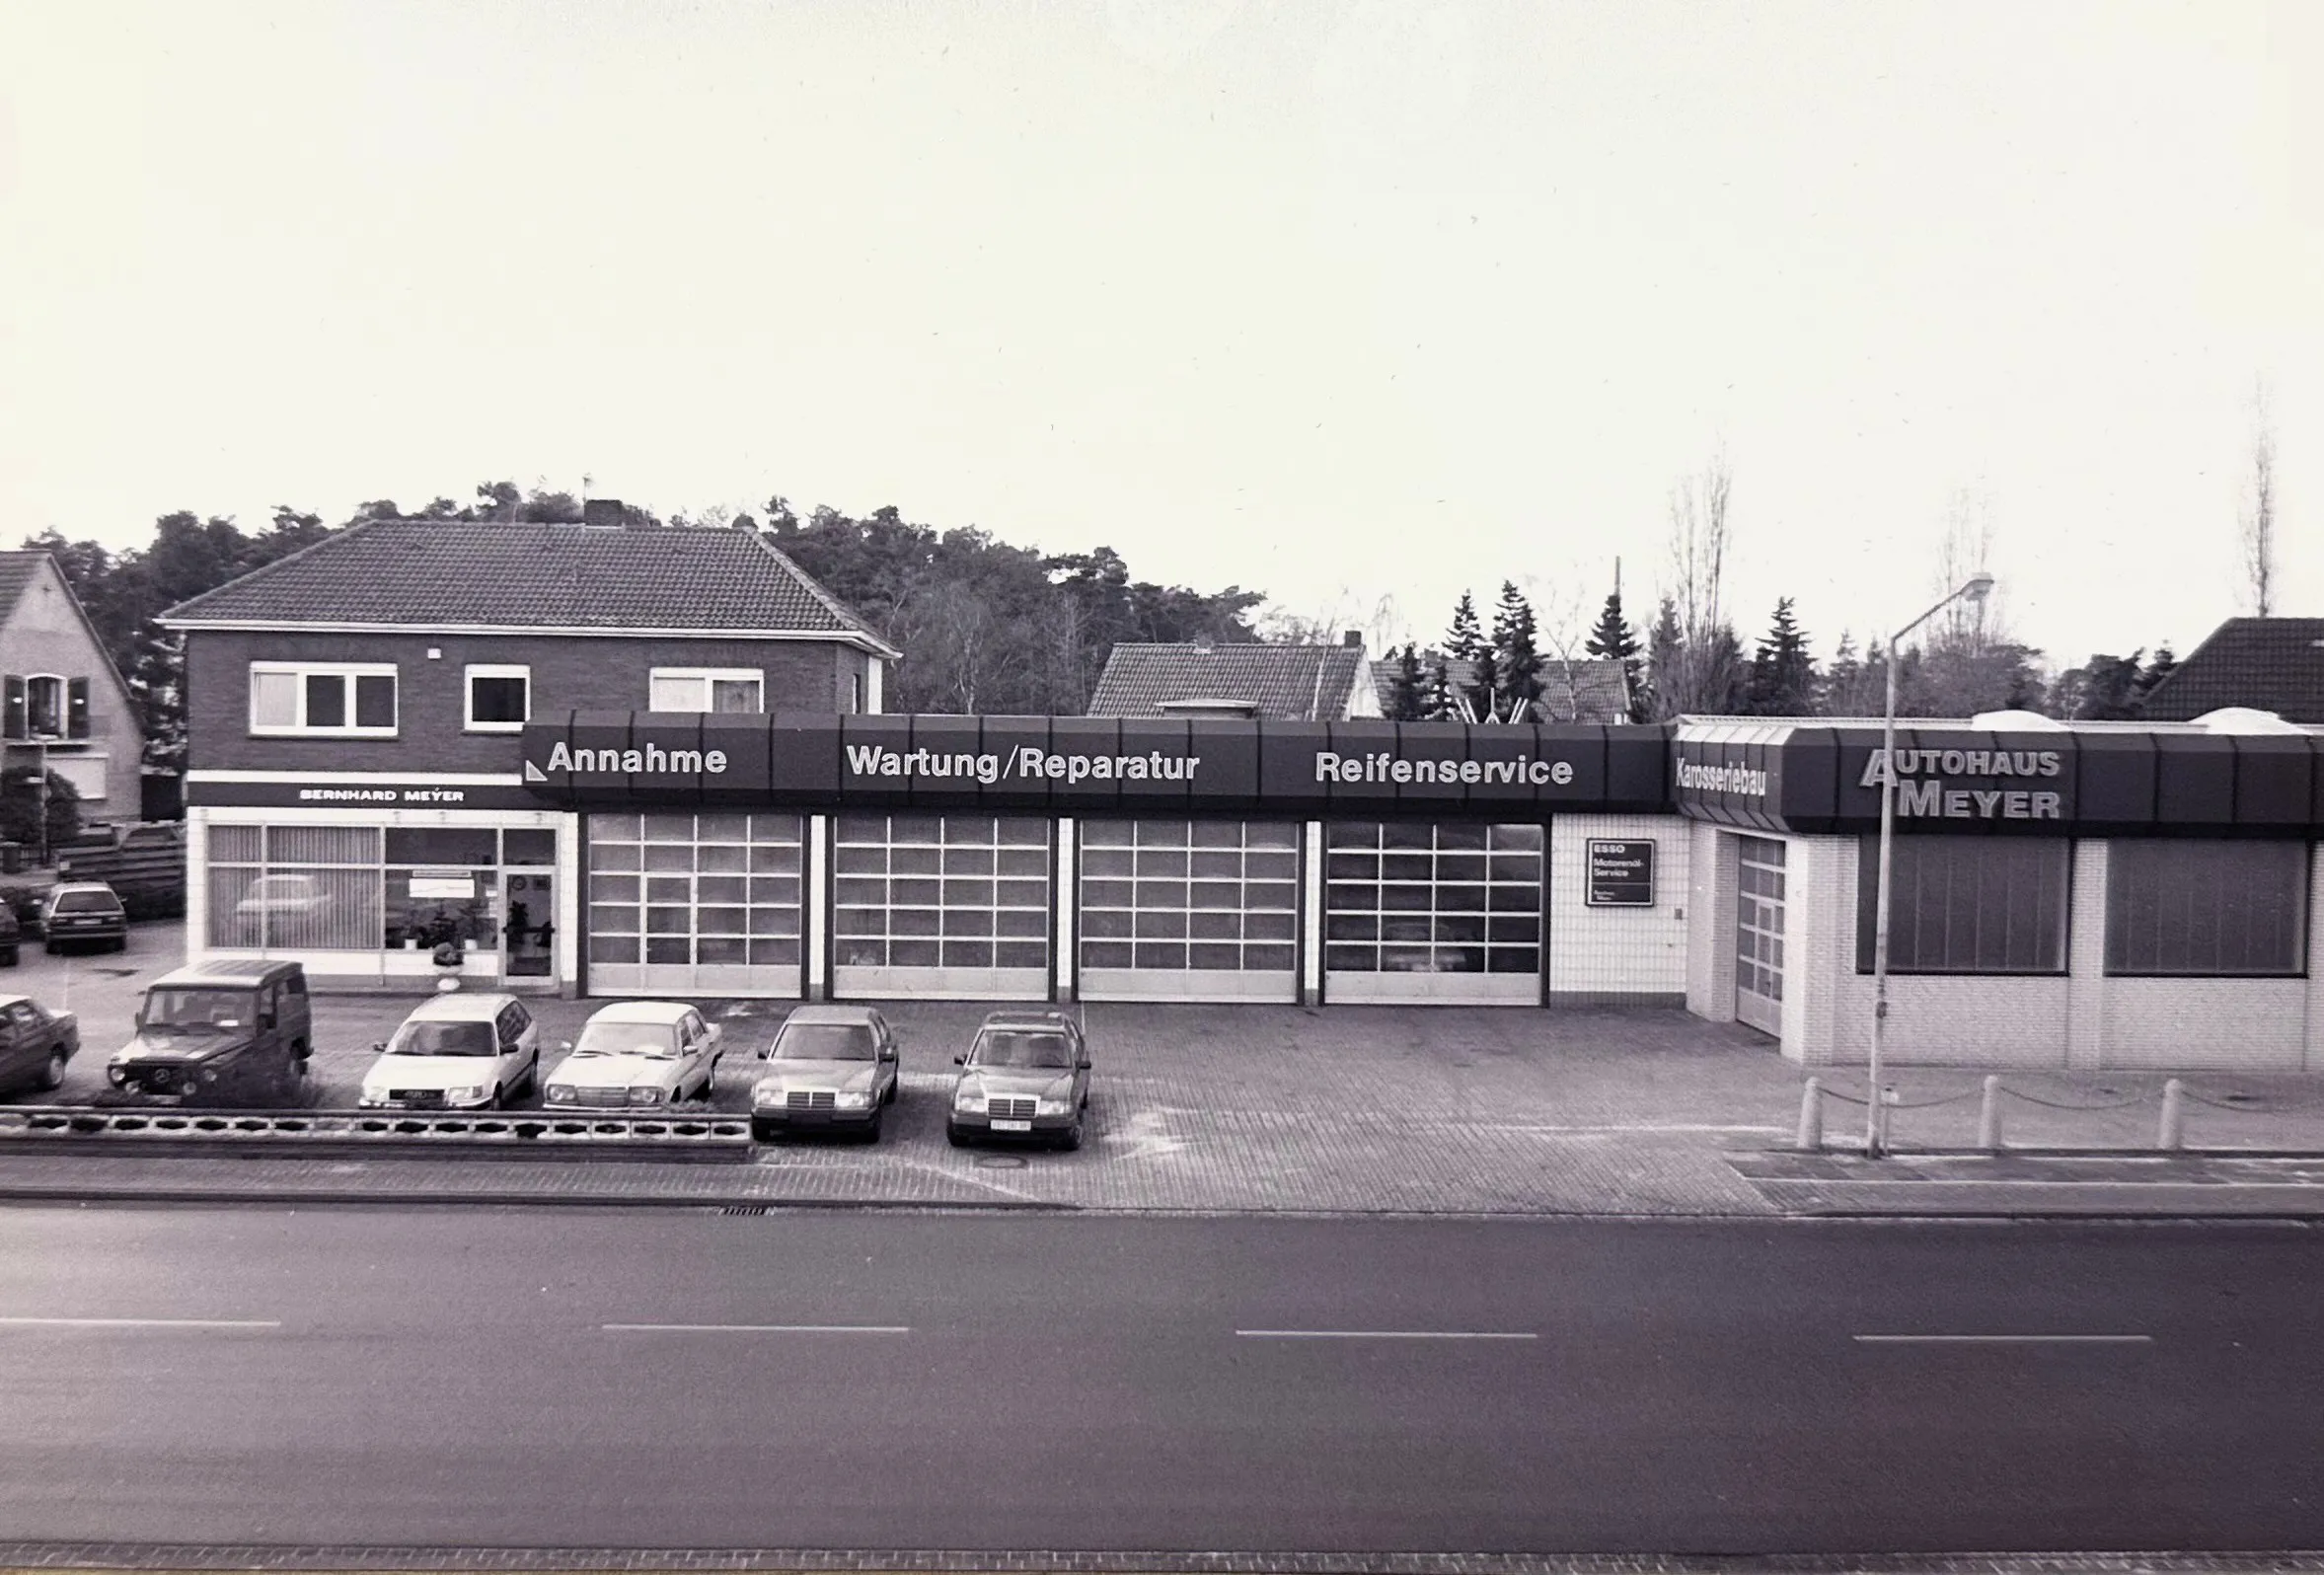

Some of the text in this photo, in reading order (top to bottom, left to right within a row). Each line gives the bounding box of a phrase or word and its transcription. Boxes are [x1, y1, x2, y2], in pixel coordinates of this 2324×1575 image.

[548, 741, 728, 774] Annahme
[1315, 752, 1574, 785] Reifenservice
[1859, 748, 2061, 788] AUTOHAUS
[1676, 757, 1767, 796] Karosseriebau
[299, 789, 465, 801] BERNHARD MEYER
[1896, 779, 2061, 819] MEYER
[1594, 844, 1626, 854] ESSO
